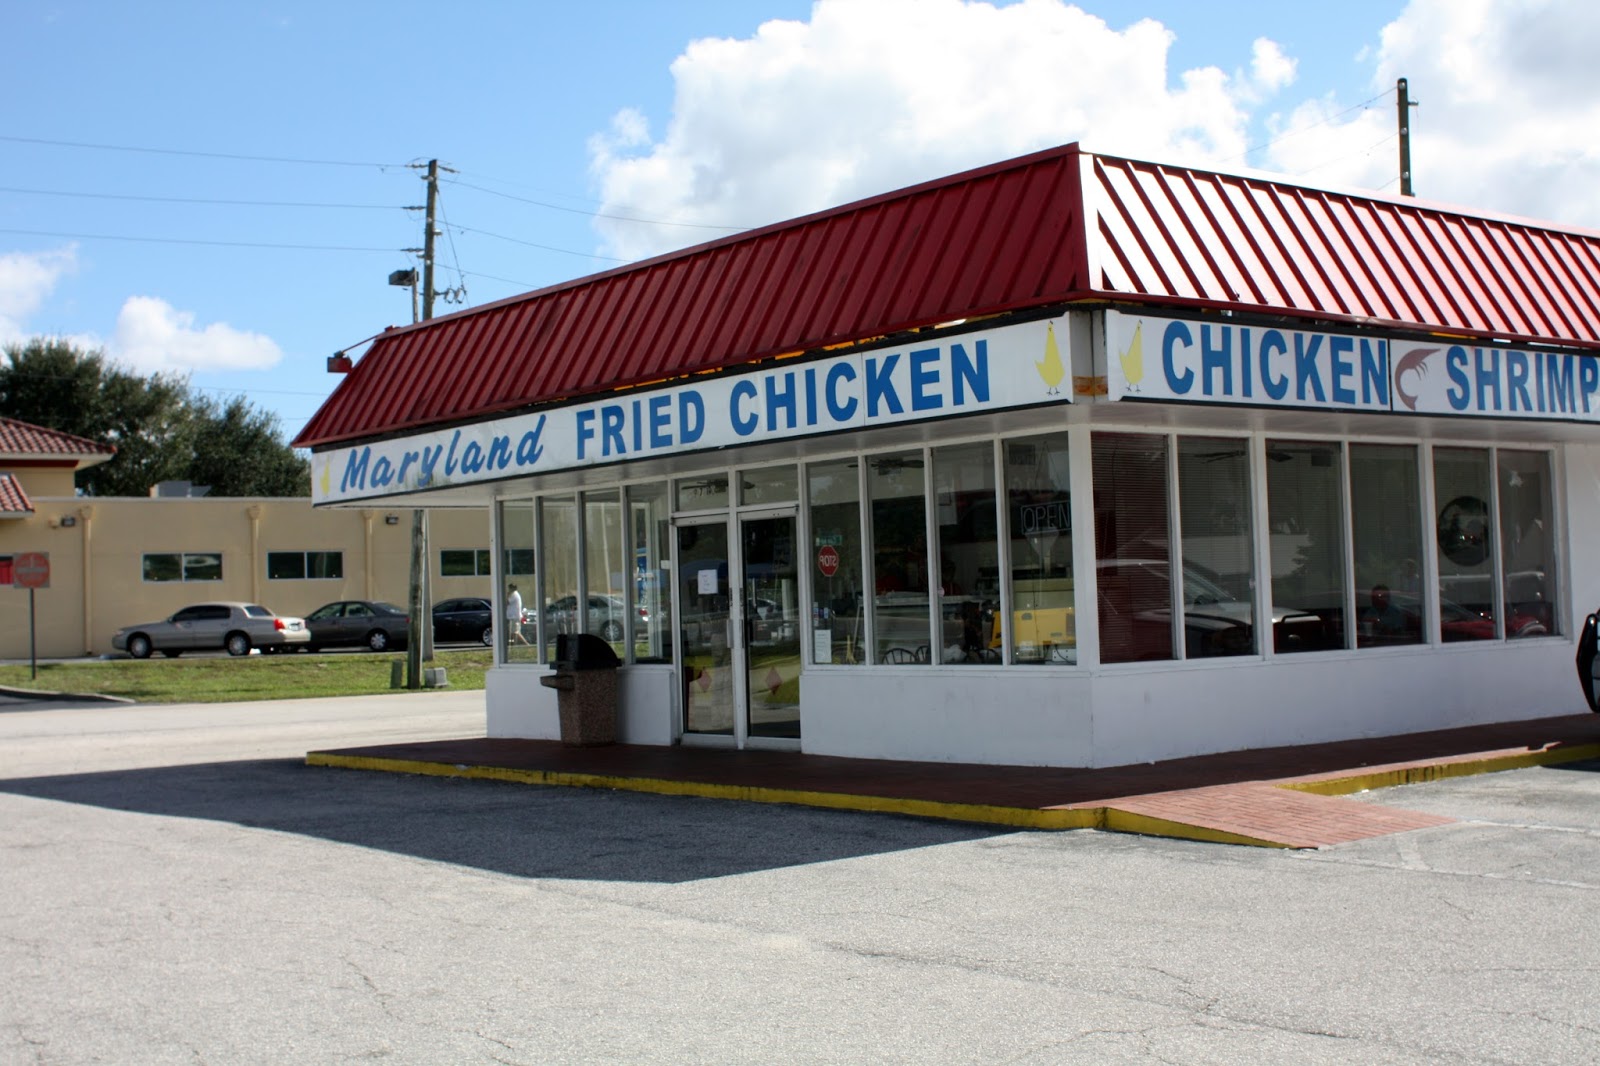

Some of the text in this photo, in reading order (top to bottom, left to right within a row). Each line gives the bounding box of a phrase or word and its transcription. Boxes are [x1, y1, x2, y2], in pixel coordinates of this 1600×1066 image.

[1162, 320, 1389, 406] CHICKEN
[1446, 345, 1599, 413] SHRIMP
[340, 339, 990, 493] Maryland FRIED CHICKEN
[1022, 502, 1071, 532] OPEN
